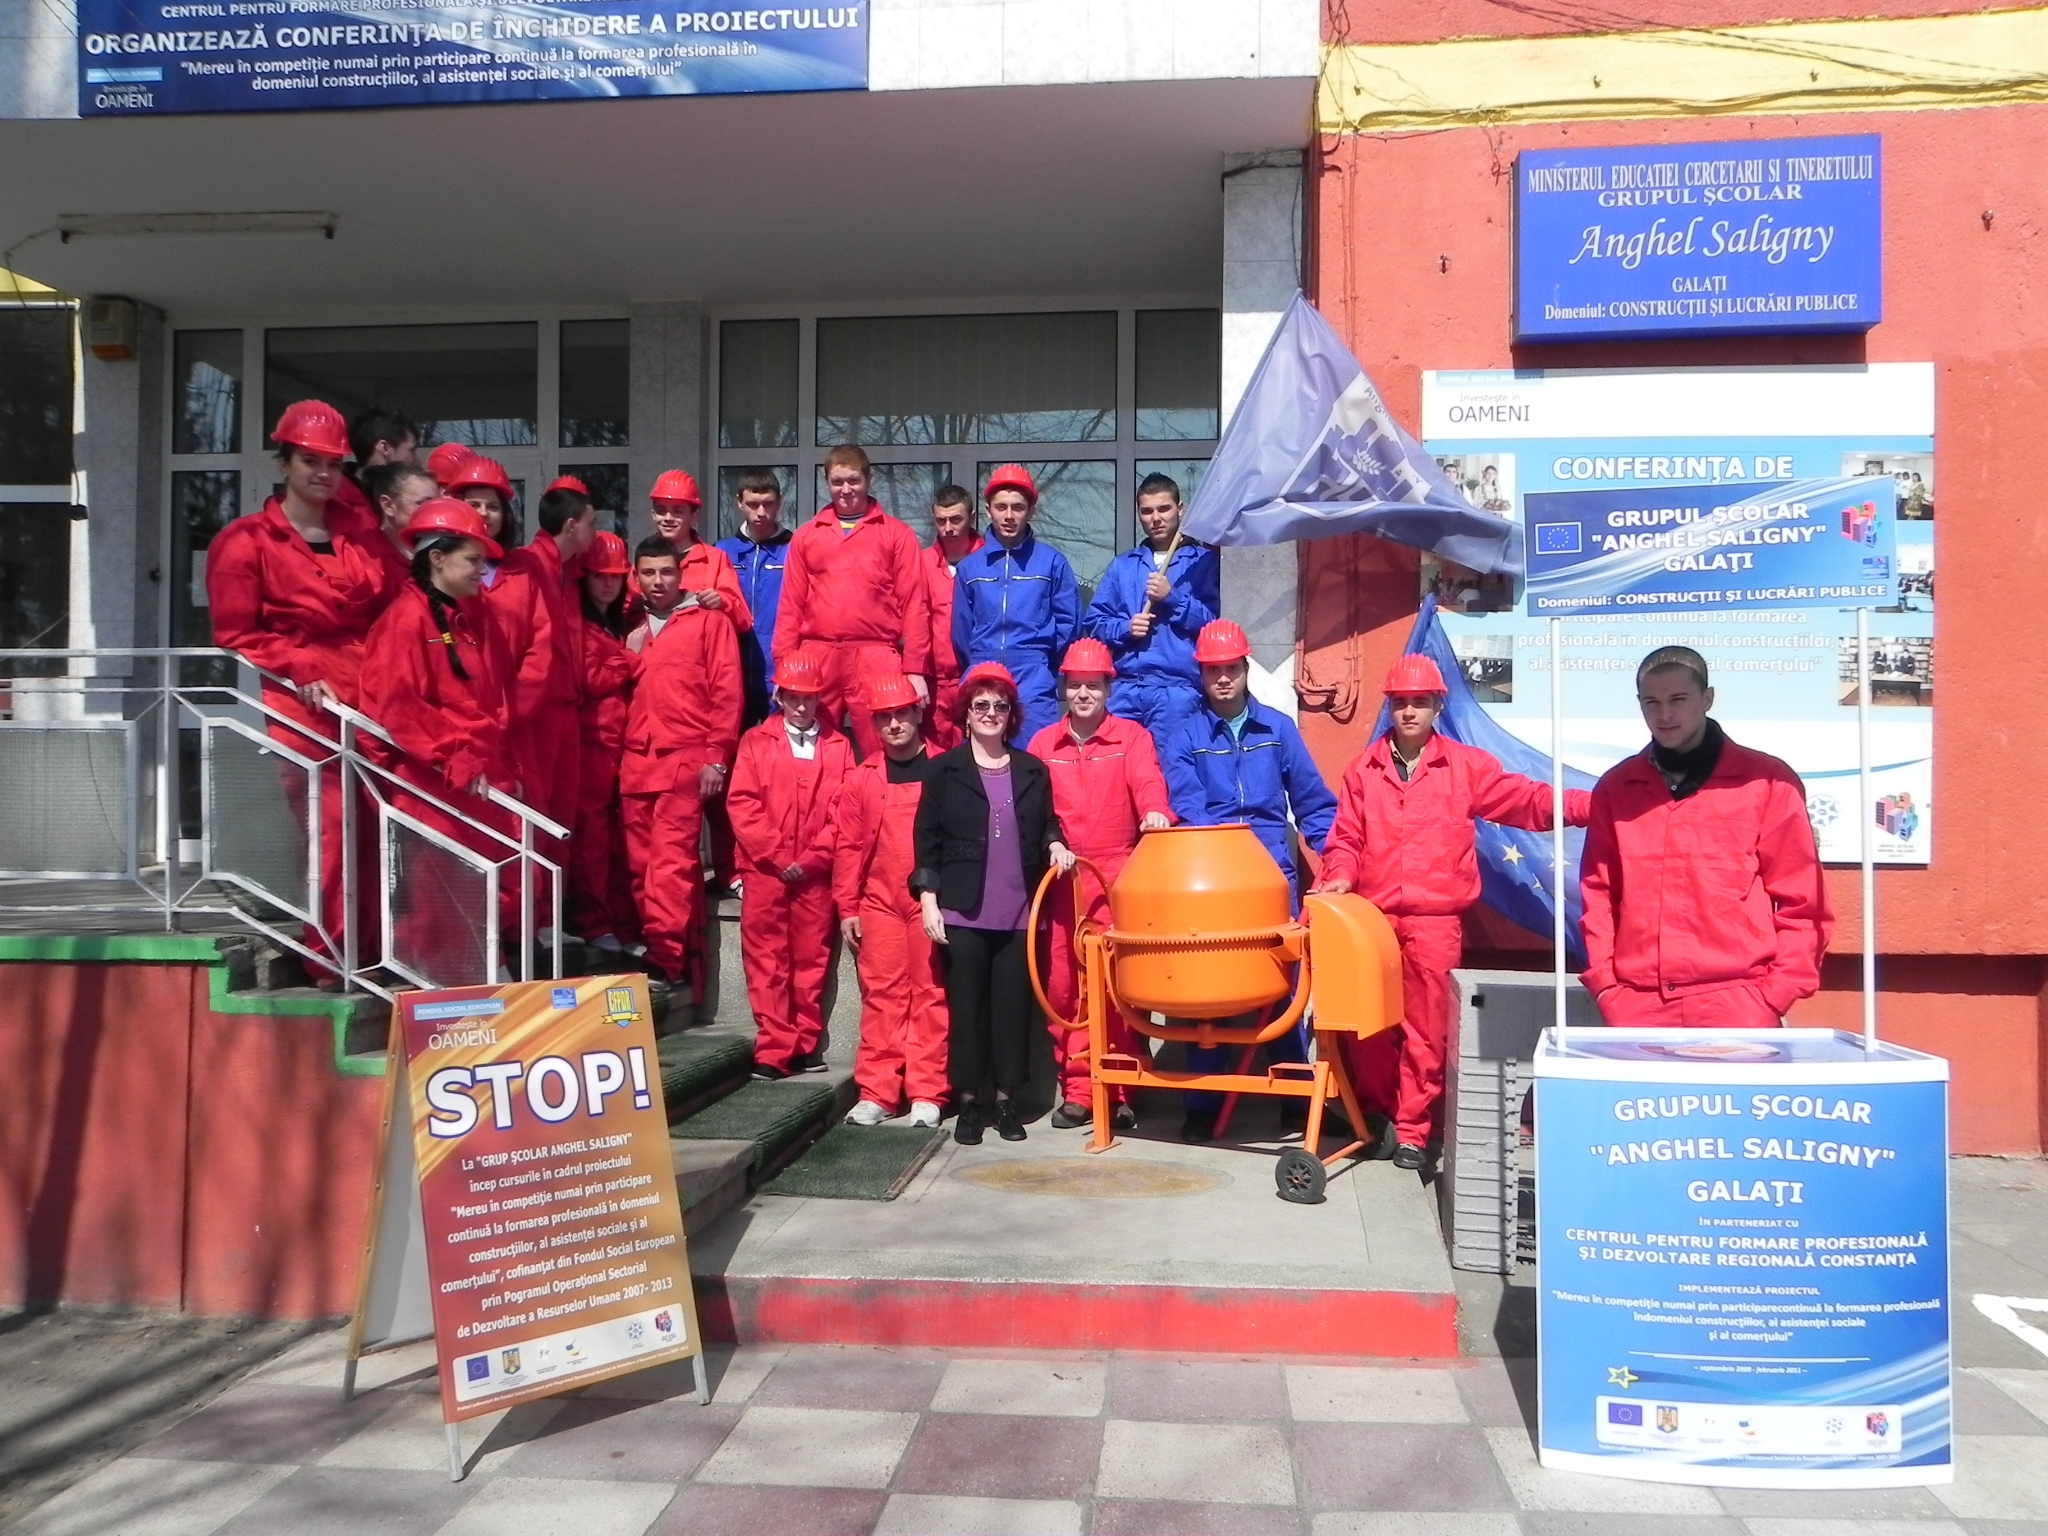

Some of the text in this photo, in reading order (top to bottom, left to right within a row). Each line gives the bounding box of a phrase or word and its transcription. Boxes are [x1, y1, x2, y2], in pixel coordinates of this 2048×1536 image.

[161, 0, 358, 18] CENTRUL PENTRU FORMARE
[85, 23, 269, 55] ORGANIZEAZĂ
[451, 21, 484, 41] DE
[493, 14, 641, 39] ÎNCHIDERE
[650, 13, 667, 33] A
[676, 7, 859, 32] PROIECTULUI
[237, 59, 251, 73] în
[334, 54, 379, 69] numai
[382, 54, 410, 70] prin
[414, 51, 491, 70] participare
[495, 49, 557, 64] continuă
[561, 47, 574, 61] la
[578, 46, 645, 61] formarea
[649, 41, 739, 61] profesională
[743, 41, 758, 56] în
[252, 74, 319, 90] domeniul
[422, 70, 435, 84] al
[511, 64, 560, 81] sociale
[578, 62, 592, 78] al
[95, 92, 154, 109] OAMENI
[1528, 155, 1873, 193] MINISTERUL EDUCATIEI CERCETARII SI TINERETULUI
[1598, 186, 1698, 208] GRUPUL
[1569, 214, 1835, 270] Anghel Saligny
[1544, 303, 1606, 320] Domeniul:
[1727, 293, 1791, 314] LUCRĂRI
[1795, 293, 1857, 312] PUBLICE
[1449, 405, 1530, 423] OAMENI
[1754, 455, 1794, 479] DE
[1607, 507, 1706, 528] GRUPUL
[1592, 525, 1827, 552] "ANGHEL SALIGNY"
[1538, 595, 1612, 609] Domeniul:
[1746, 584, 1815, 602] LUCRĂRI
[1819, 585, 1887, 599] PUBLICE
[1621, 632, 1637, 648] în
[1641, 631, 1719, 648] domeniul
[1528, 656, 1543, 671] al
[429, 1028, 497, 1050] OAMENI
[426, 1047, 651, 1139] STOP!
[1614, 1094, 1741, 1122] GRUPUL
[462, 1159, 474, 1171] La
[476, 1152, 509, 1168] "GRUP
[550, 1140, 588, 1156] ANGHEL
[589, 1132, 633, 1150] SALIGNY"
[1590, 1137, 1896, 1169] "ANGHEL SALIGNY"
[469, 1179, 497, 1193] încep
[498, 1169, 541, 1188] cursurile
[554, 1162, 583, 1179] cadrul
[584, 1153, 632, 1175] proiectului
[489, 1198, 500, 1212] în
[554, 1184, 583, 1200] numai
[585, 1181, 603, 1197] prin
[605, 1174, 652, 1194] participare
[448, 1223, 492, 1244] continuă
[493, 1222, 503, 1235] la
[505, 1216, 549, 1233] formarea
[551, 1201, 608, 1226] profesională
[621, 1192, 660, 1211] domeniul
[1698, 1216, 1799, 1228] ÎN PARTENERIAT CU
[539, 1236, 548, 1249] al
[597, 1221, 628, 1238] sociale
[639, 1215, 648, 1229] al
[1566, 1227, 1928, 1250] CENTRUL PENTRU FORMARE PROFESIONALĂ
[557, 1255, 572, 1269] din
[574, 1247, 605, 1264] Fondul
[607, 1240, 634, 1258] Social
[635, 1234, 676, 1251] European
[1602, 1248, 1711, 1266] DEZVOLTARE
[1716, 1251, 1816, 1267] REGIONALĂ
[481, 1294, 502, 1311] prin
[504, 1281, 551, 1304] Pogramul
[608, 1260, 648, 1280] Sectorial
[1678, 1283, 1821, 1296] IMPLEMENTEAZĂ PROIECTUL
[457, 1277, 673, 1339] de Dezvoltare a Resurselor Umane 2007- 2013
[1592, 1292, 1603, 1305] în
[1663, 1300, 1695, 1310] numai
[1698, 1301, 1719, 1313] prin
[1824, 1302, 1834, 1313] la
[1836, 1302, 1881, 1313] formarea
[1884, 1298, 1941, 1314] profesională
[1719, 1330, 1729, 1340] al
[1768, 1317, 1778, 1327] al
[1831, 1317, 1866, 1327] sociale
